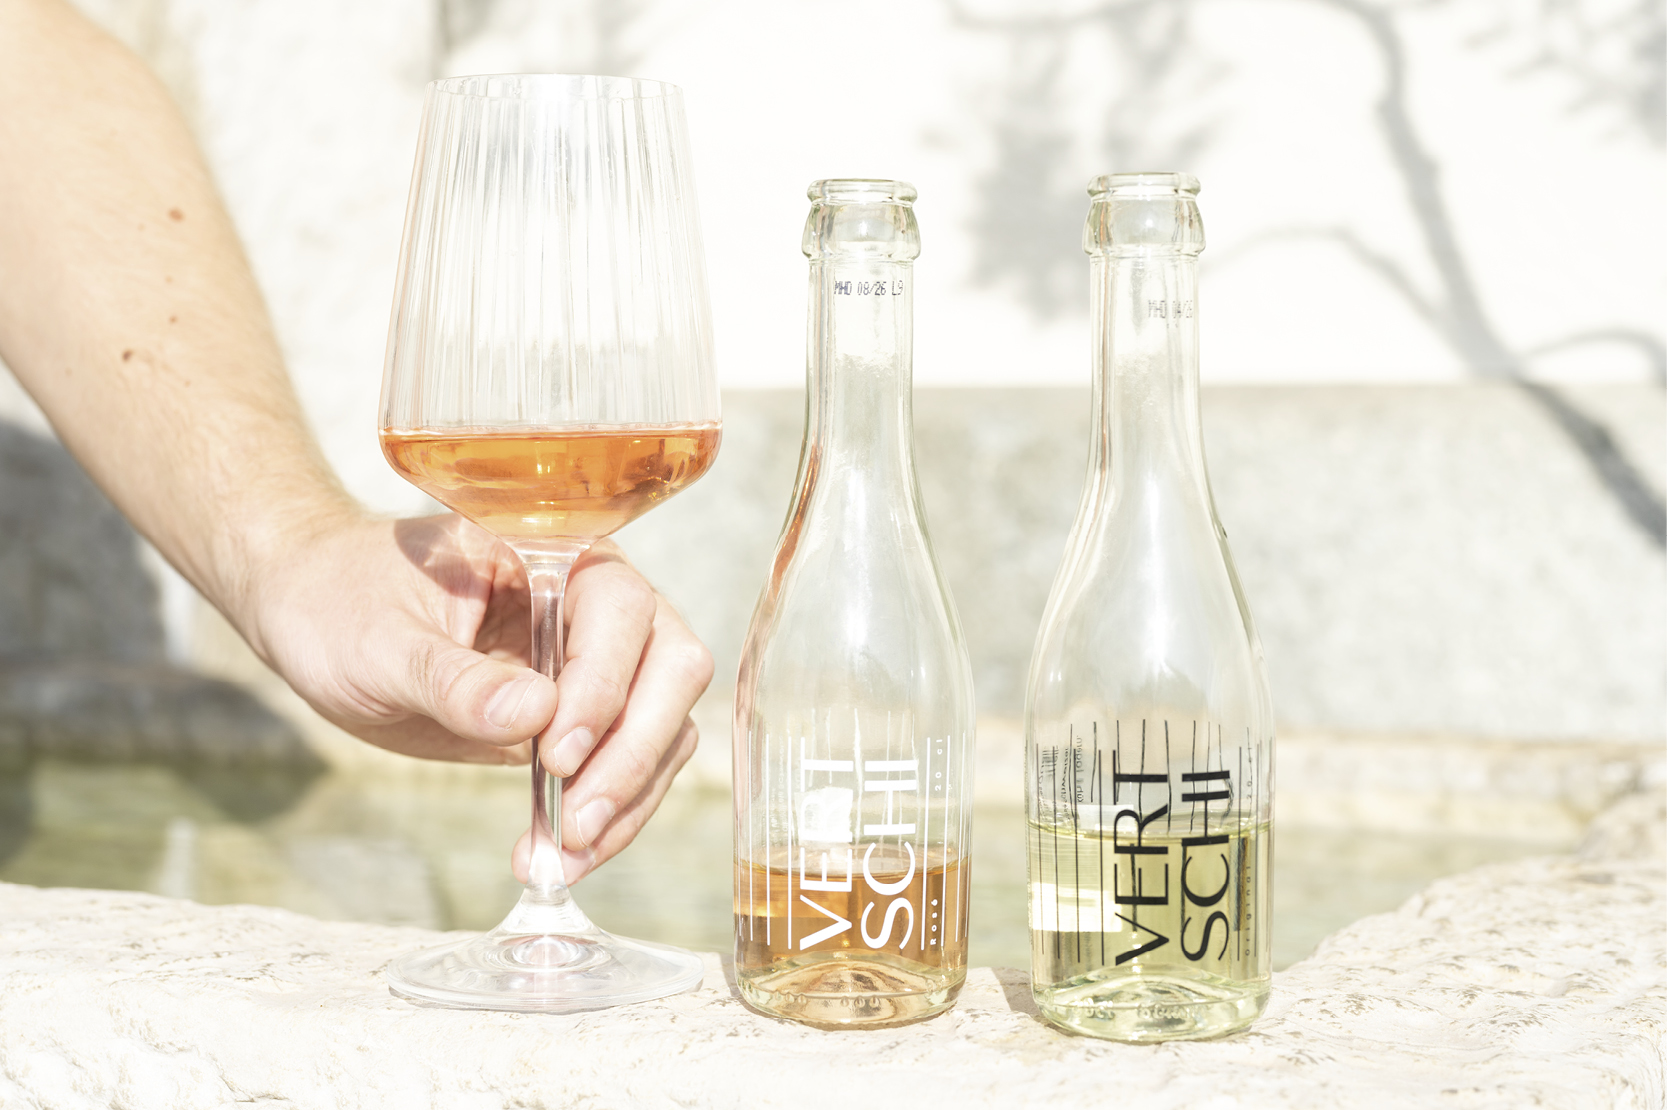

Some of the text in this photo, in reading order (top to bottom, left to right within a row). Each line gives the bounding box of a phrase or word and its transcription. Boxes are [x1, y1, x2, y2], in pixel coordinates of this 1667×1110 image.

[857, 281, 887, 296] 08/26
[935, 772, 942, 792] 20
[936, 739, 943, 755] cl
[800, 737, 854, 950] VERT
[860, 760, 918, 949] SCHI
[1113, 750, 1169, 966] VERT
[1180, 770, 1230, 961] SCHI
